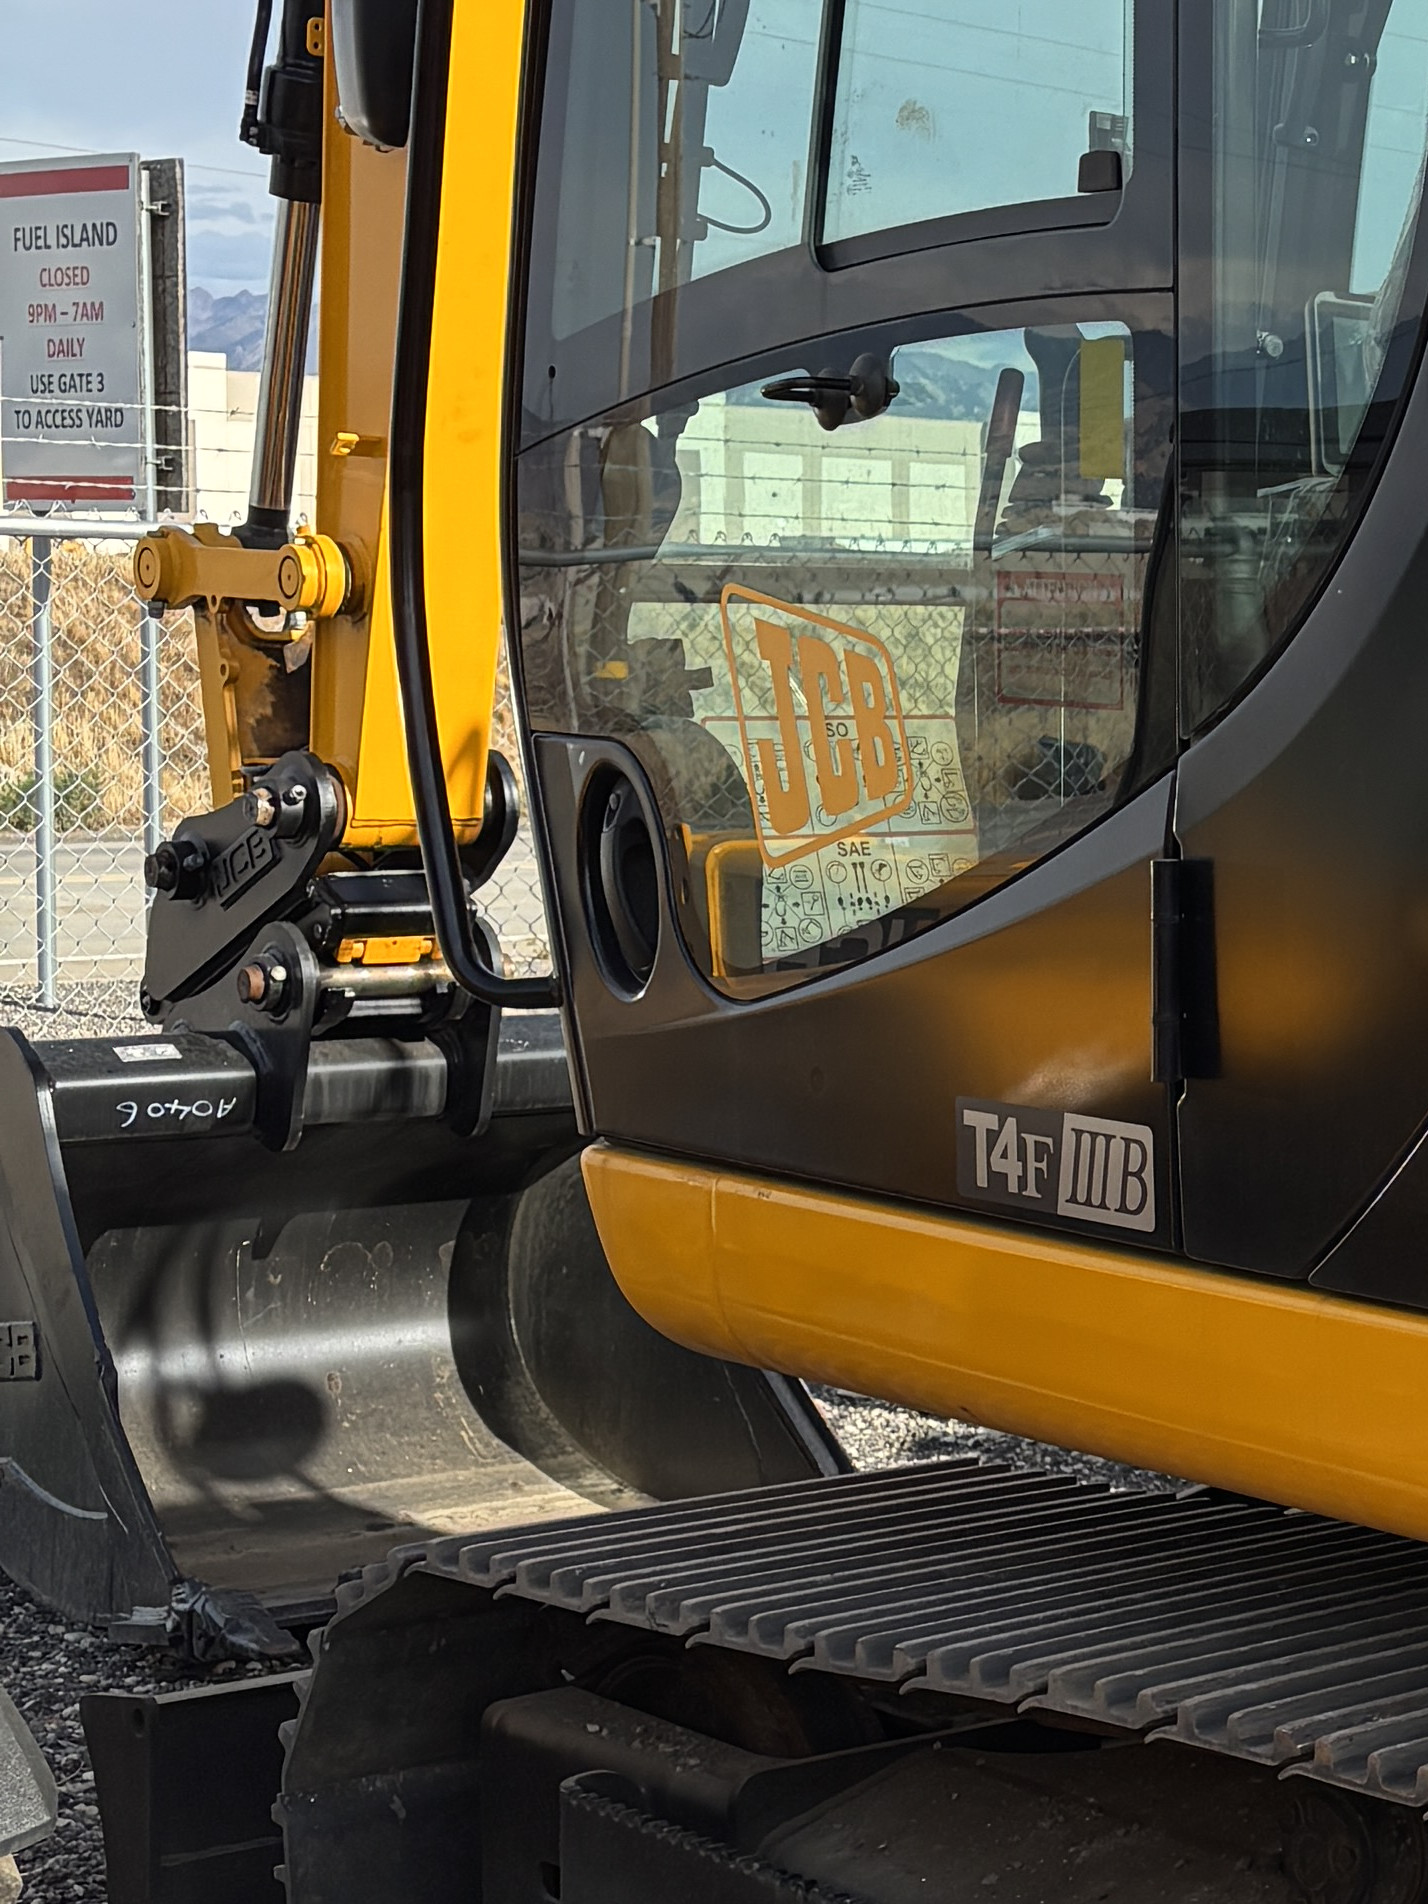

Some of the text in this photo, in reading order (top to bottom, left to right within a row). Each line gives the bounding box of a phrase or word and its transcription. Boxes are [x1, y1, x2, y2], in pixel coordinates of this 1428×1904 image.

[14, 221, 118, 251] FUEL ISLAND
[40, 266, 90, 287] CLOSED
[28, 303, 57, 323] 9PM
[72, 301, 104, 322] 7AM
[47, 337, 85, 358] DAILY
[30, 372, 104, 394] USE GATE 3
[14, 408, 124, 429] TO ACCESS YARD
[754, 618, 899, 835] JCB
[825, 722, 848, 737] SO
[837, 841, 871, 857] SAE
[116, 1097, 236, 1127] A0406
[963, 1109, 1148, 1216] T4F IIIB
